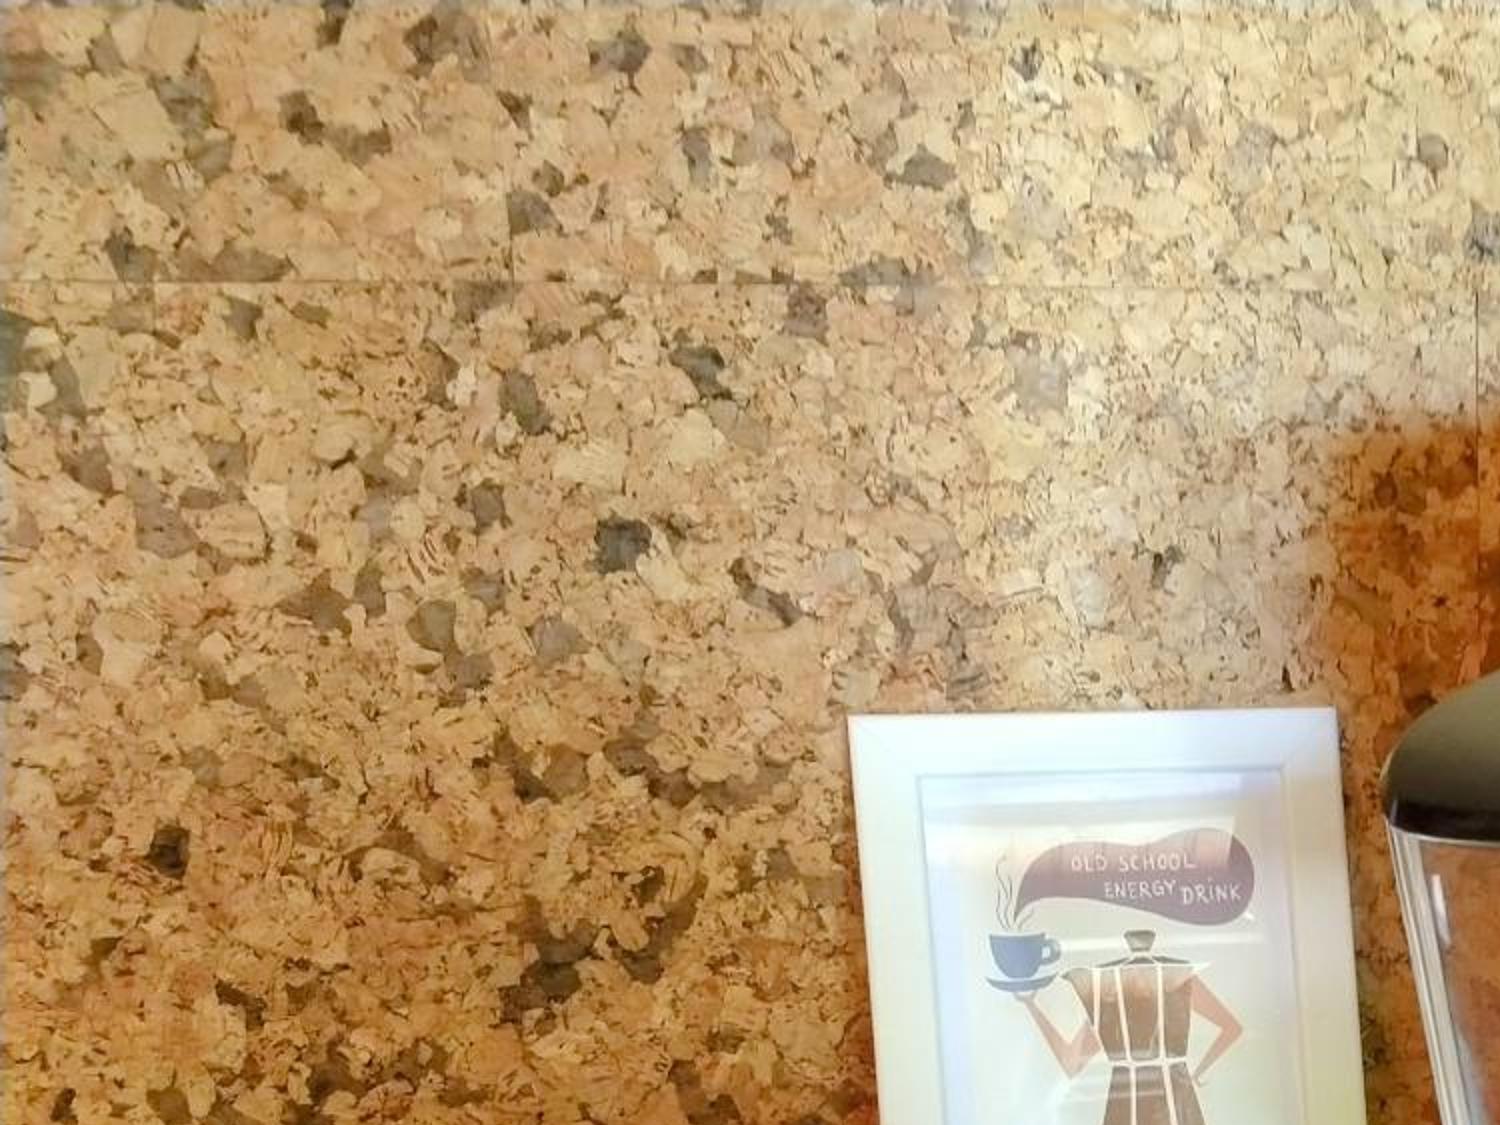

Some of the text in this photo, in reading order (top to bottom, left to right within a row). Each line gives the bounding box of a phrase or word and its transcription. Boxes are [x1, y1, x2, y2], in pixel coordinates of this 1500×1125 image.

[1071, 851, 1198, 873] OLD SCHOOL
[1104, 880, 1176, 898] ENERGY
